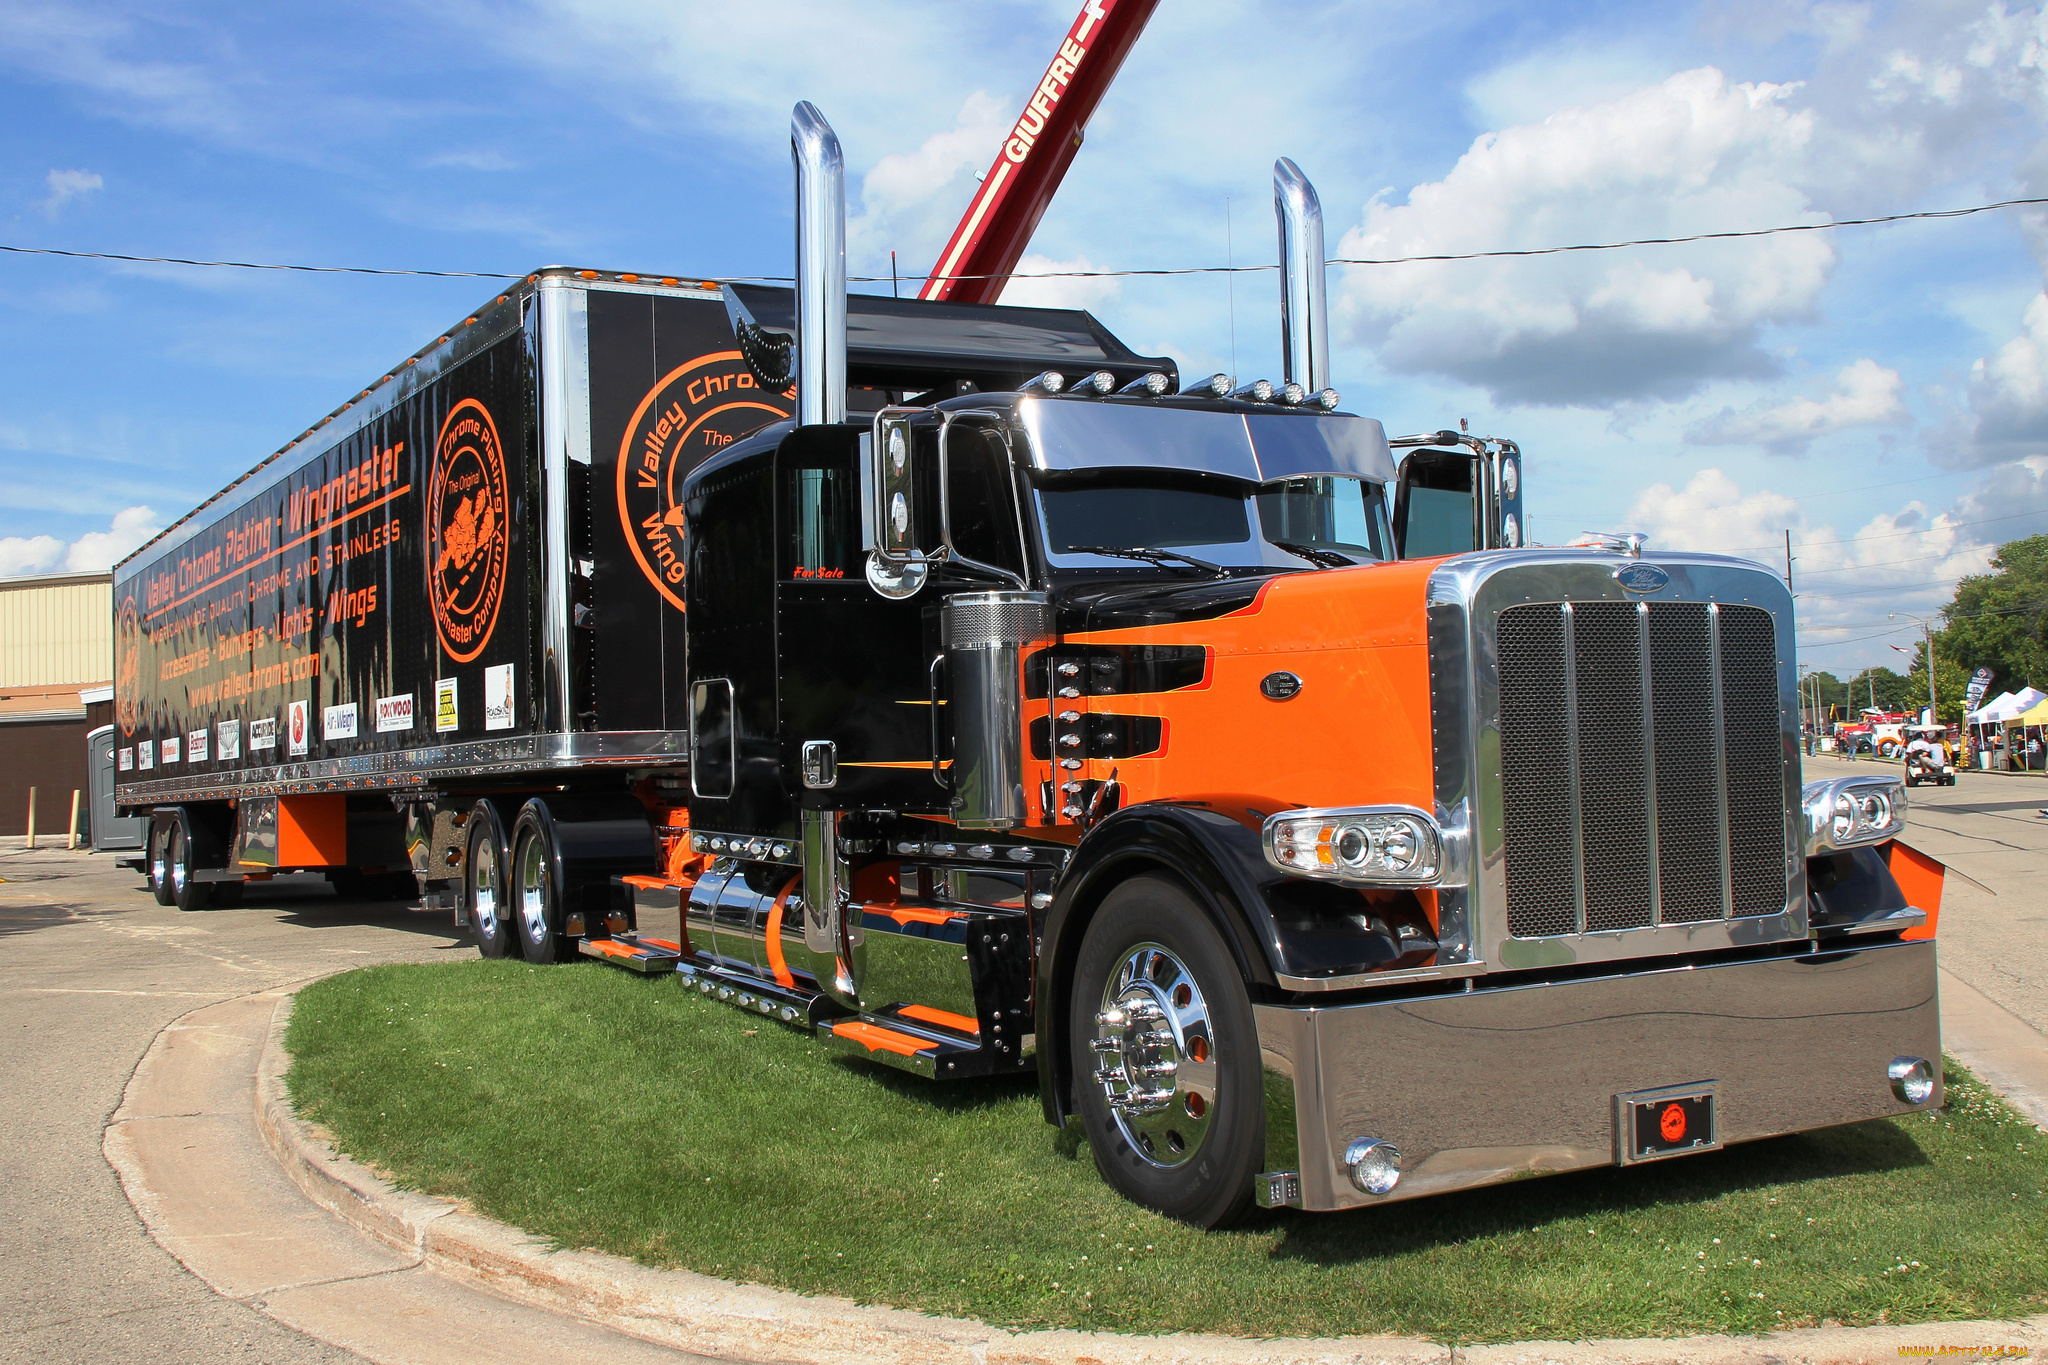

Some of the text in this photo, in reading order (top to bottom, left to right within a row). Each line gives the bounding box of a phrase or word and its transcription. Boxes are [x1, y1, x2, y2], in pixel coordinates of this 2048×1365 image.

[1005, 37, 1086, 163] GIUFFRE
[443, 418, 481, 461] Chrome
[481, 427, 503, 513] Plating
[448, 468, 481, 495] The Original
[638, 402, 688, 488] Valley
[702, 430, 734, 446] The
[147, 571, 177, 610] Valley
[179, 546, 221, 593] Chrome
[225, 516, 272, 568] Plating
[290, 441, 404, 534] Wingmaster
[209, 588, 246, 620] QUALITY
[248, 567, 292, 603] CHROME
[295, 556, 320, 583] AND
[325, 518, 401, 570] STAINLESS
[793, 566, 844, 579] For Sale
[432, 519, 504, 643] Wingmaster Company
[160, 647, 210, 682] Accessories
[219, 626, 265, 662] Bumpers
[276, 604, 314, 650] Lights
[330, 585, 378, 628] Wings
[191, 653, 320, 708] www.valleychrome.com
